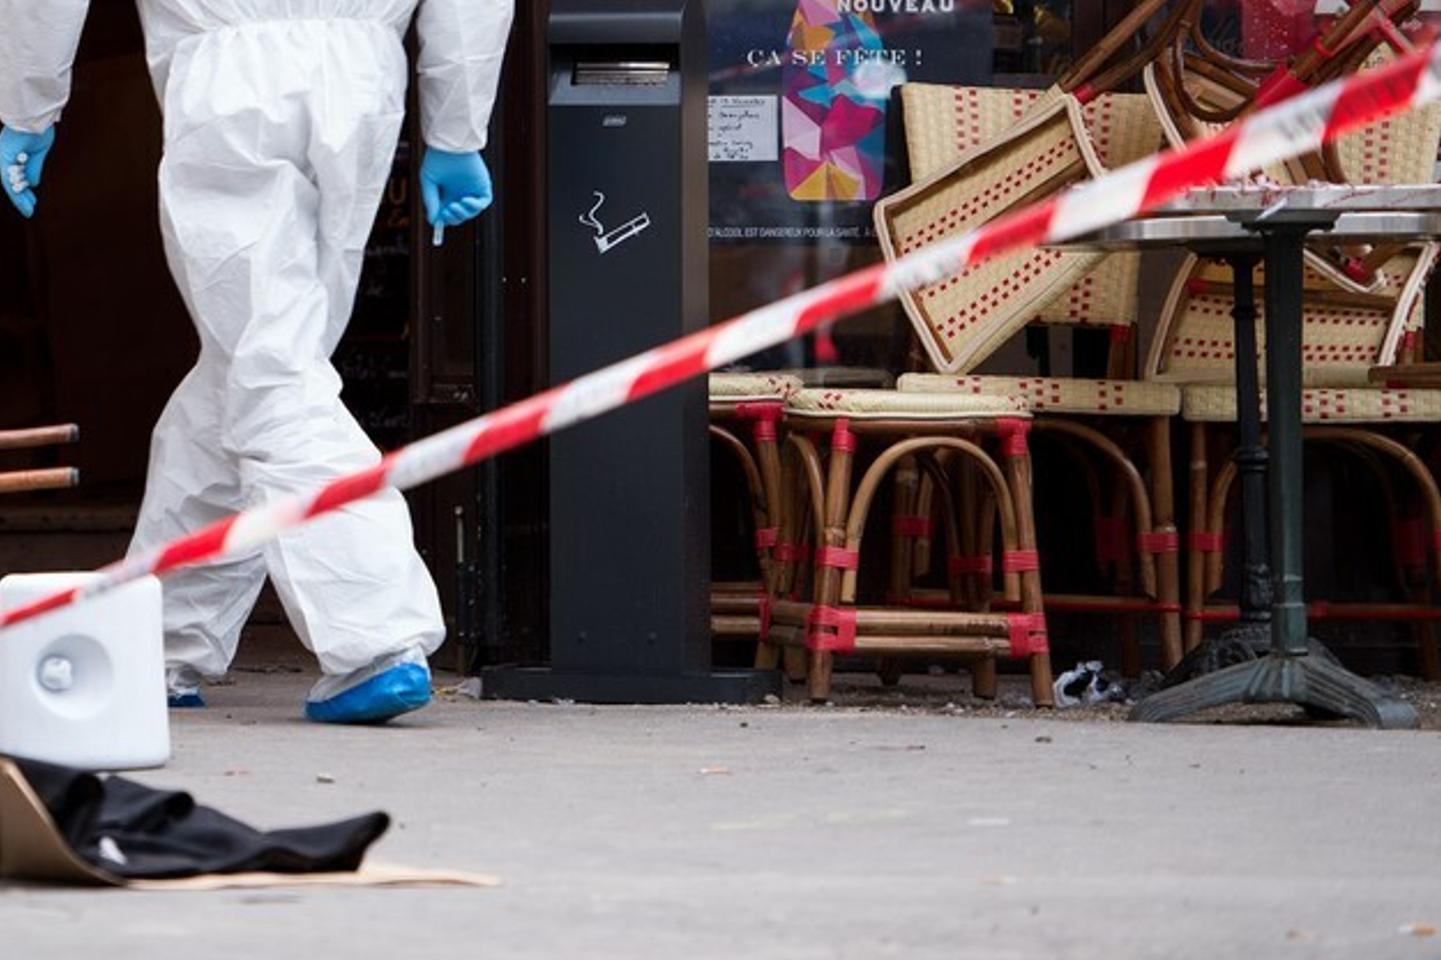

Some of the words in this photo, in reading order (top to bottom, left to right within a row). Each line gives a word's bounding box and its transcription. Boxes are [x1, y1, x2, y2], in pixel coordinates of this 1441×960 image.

[747, 50, 781, 68] ÇA
[791, 50, 826, 66] SE
[836, 47, 906, 66] FÊTE
